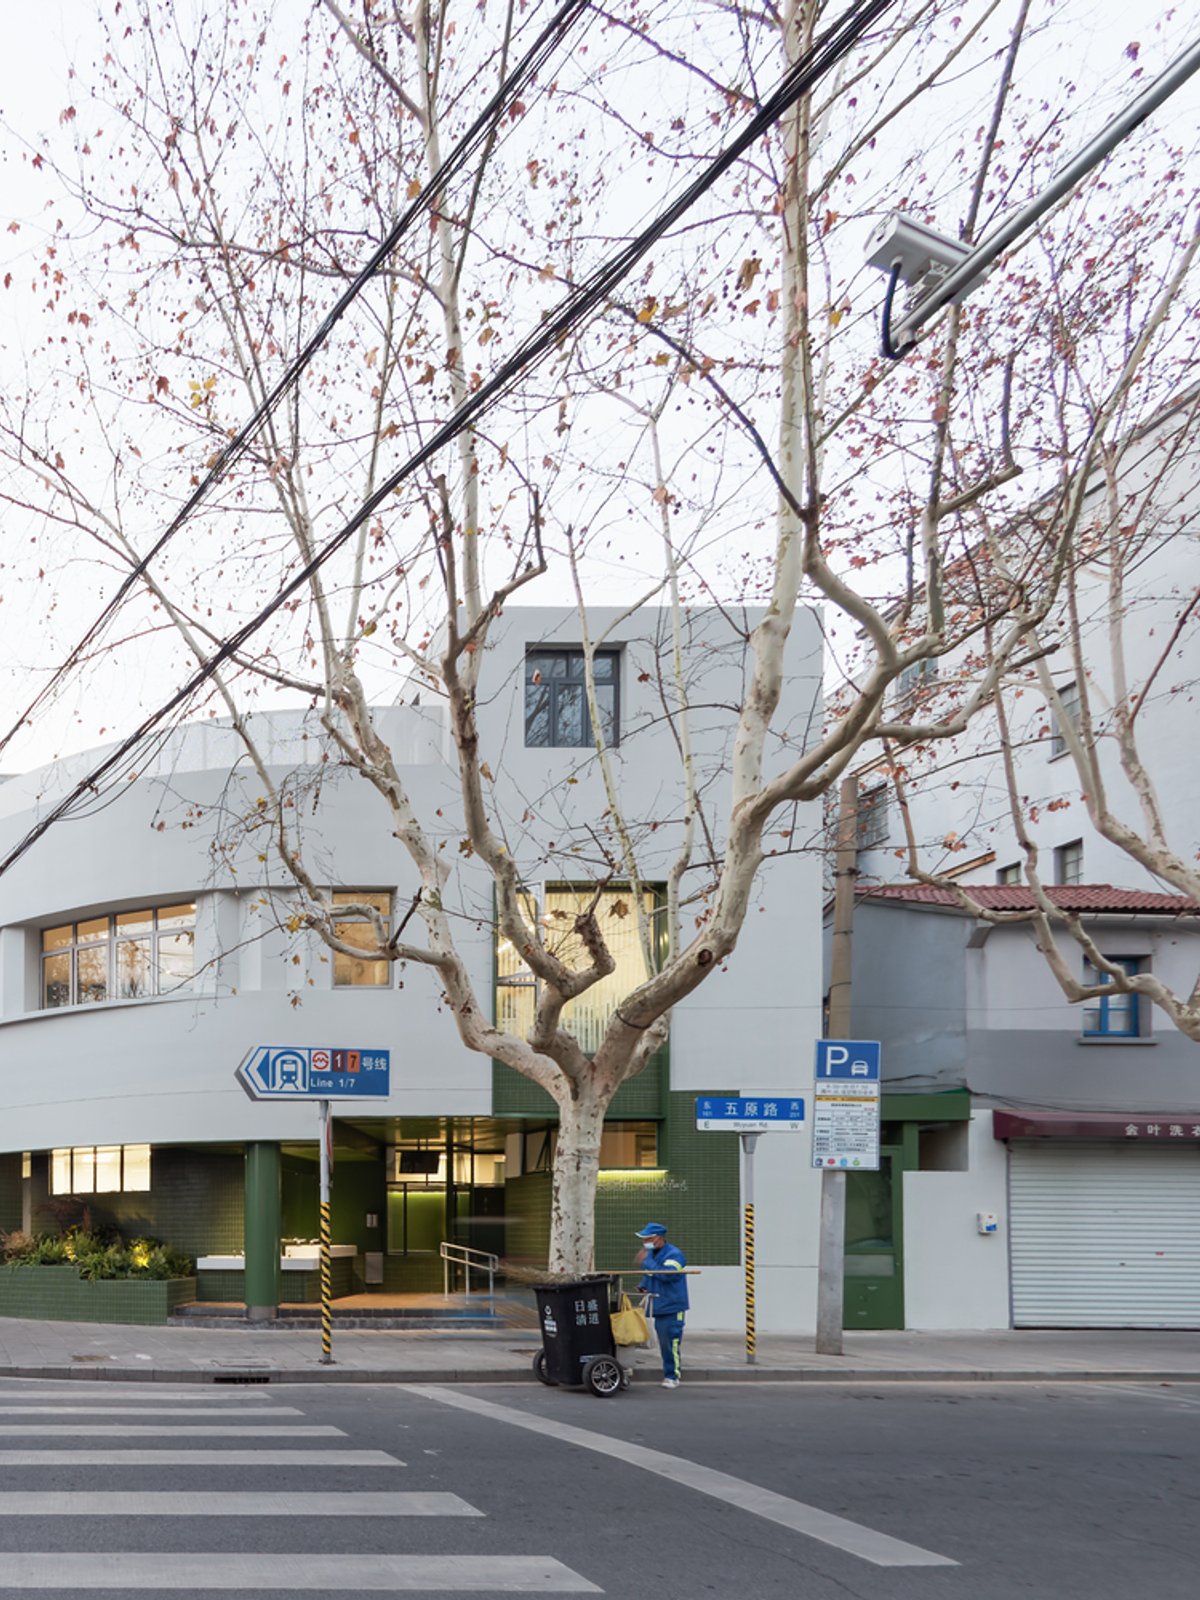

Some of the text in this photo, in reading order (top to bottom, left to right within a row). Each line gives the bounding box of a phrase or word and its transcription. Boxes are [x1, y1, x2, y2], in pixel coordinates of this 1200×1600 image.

[335, 1053, 387, 1071] 1 7 号线
[826, 1046, 849, 1076] P
[310, 1077, 355, 1088] Line 1/7
[724, 1102, 778, 1117] 五原路
[703, 1121, 710, 1129] E
[789, 1121, 800, 1129] W
